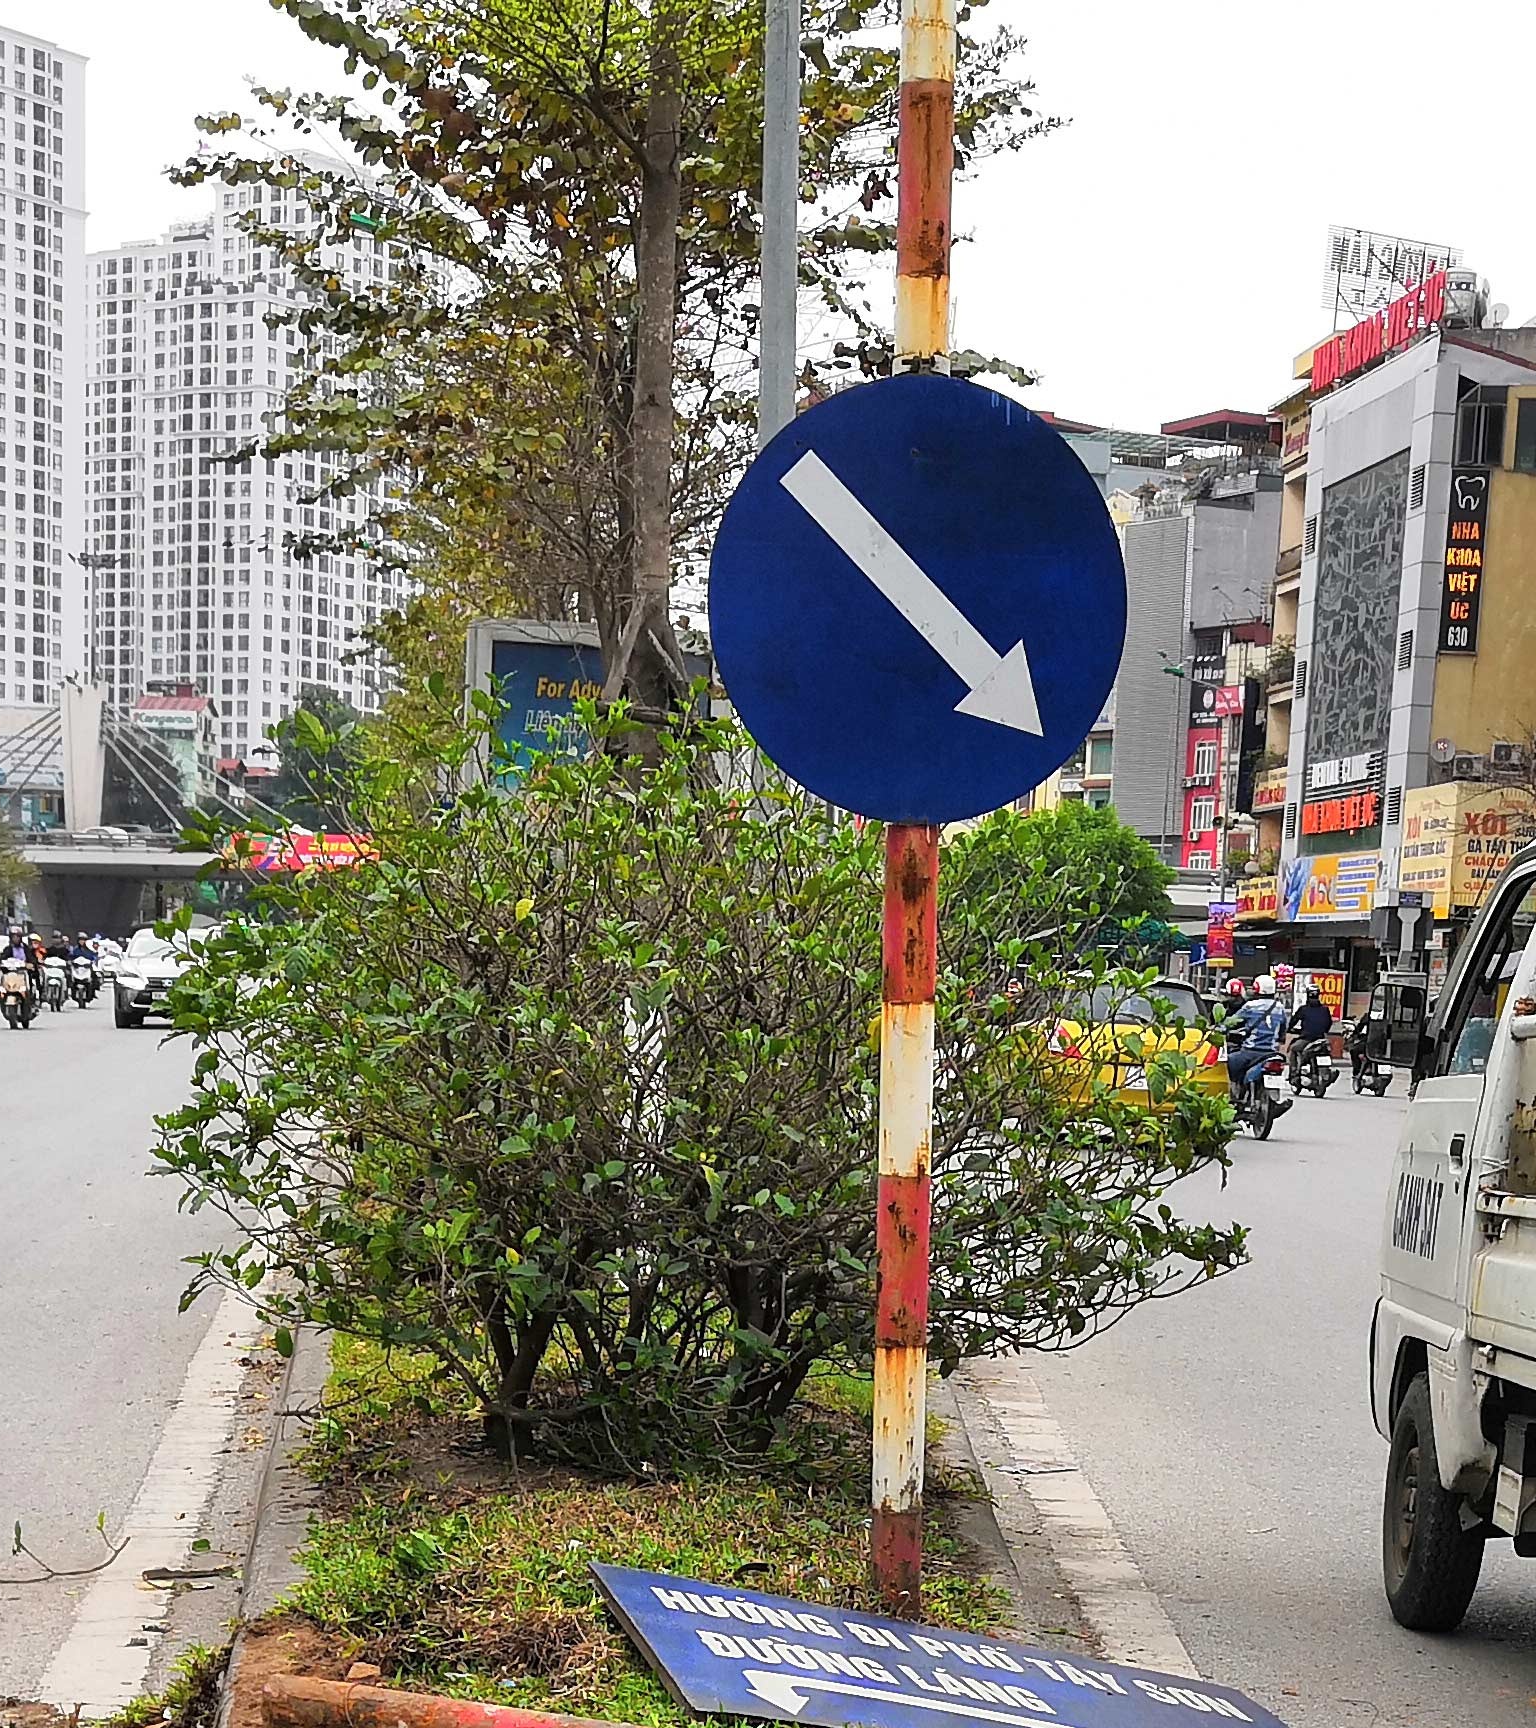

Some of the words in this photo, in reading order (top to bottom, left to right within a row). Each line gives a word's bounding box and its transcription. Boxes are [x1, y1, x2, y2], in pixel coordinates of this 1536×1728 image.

[1452, 522, 1479, 539] NHA
[1448, 571, 1477, 596] VIỆT
[1448, 627, 1468, 646] 630
[537, 677, 564, 699] For
[133, 711, 194, 727] Kangaroo
[1464, 808, 1508, 836] XÔI
[650, 1586, 843, 1639] HƯỚNG
[843, 1621, 912, 1652] ĐI
[909, 1633, 1025, 1673] PHỐ
[1024, 1656, 1129, 1696] TÂY
[1133, 1679, 1255, 1723] SƠN
[696, 1629, 901, 1686] ĐƯỜNG
[897, 1664, 1058, 1716] LÁNG
